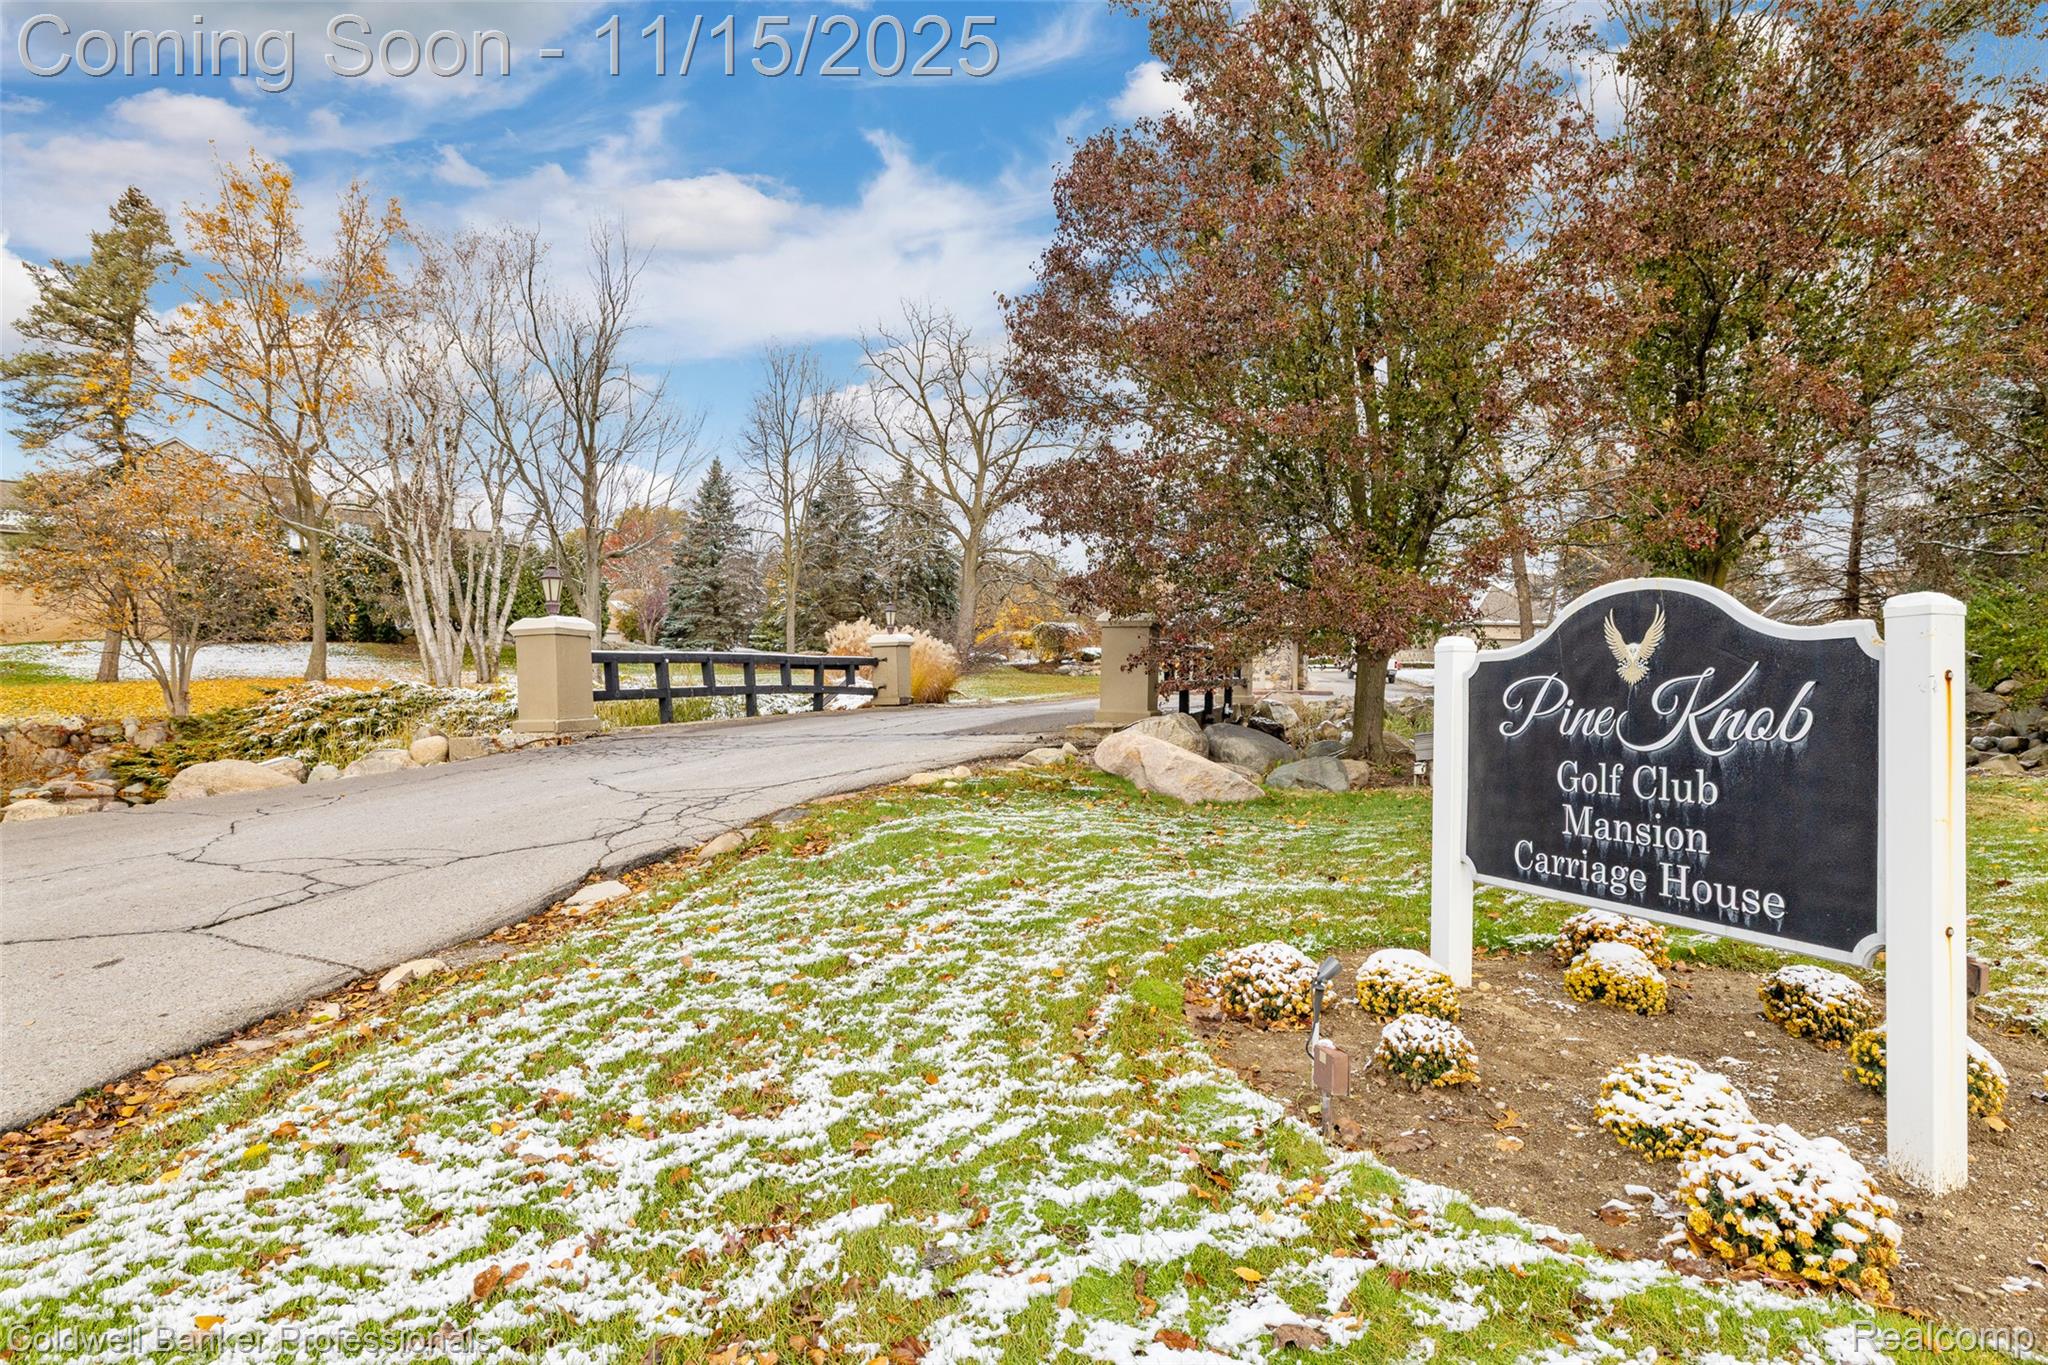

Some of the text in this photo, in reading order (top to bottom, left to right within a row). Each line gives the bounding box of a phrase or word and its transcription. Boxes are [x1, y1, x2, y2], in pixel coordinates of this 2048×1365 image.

[1499, 661, 1818, 757] Pine Knob
[1557, 760, 1719, 806] Golf Club
[1562, 803, 1710, 855] Mansion
[1513, 839, 1786, 920] Carriage House
